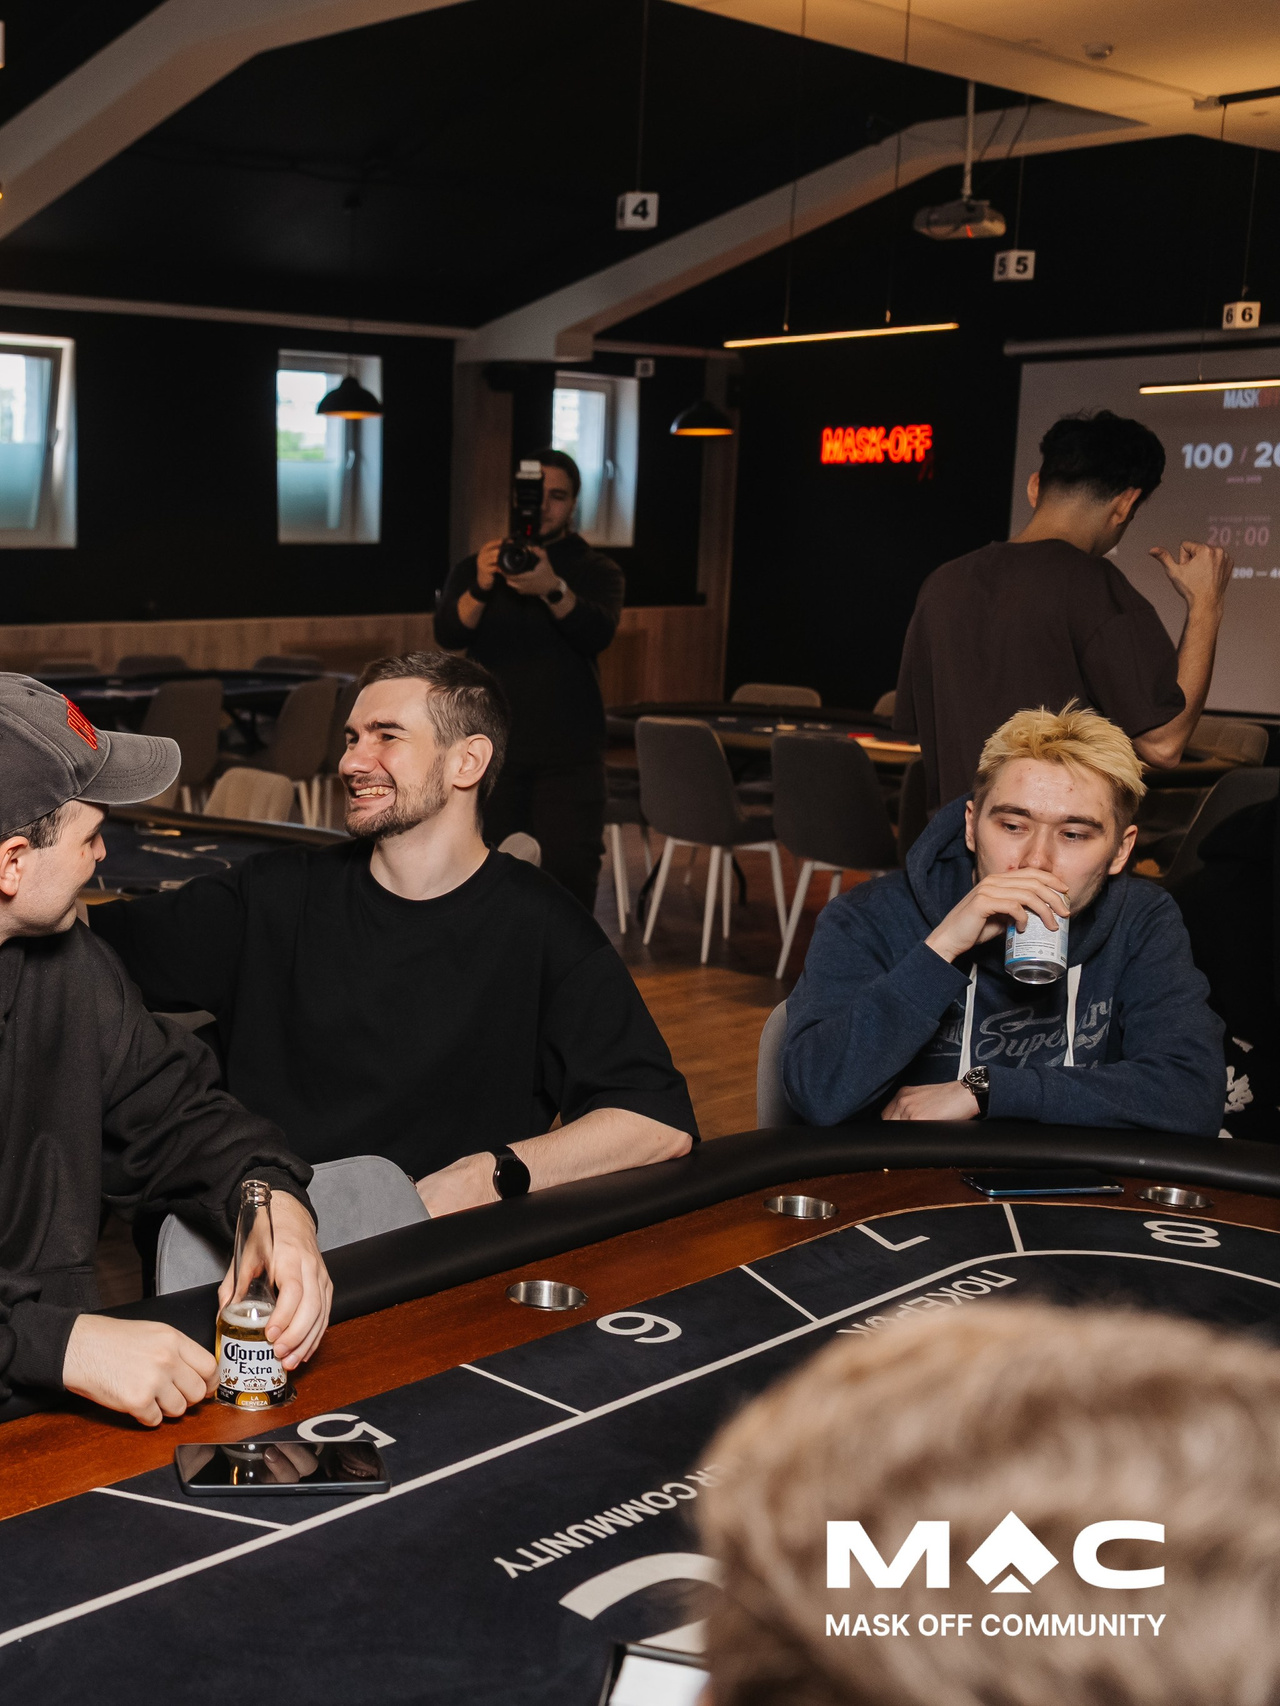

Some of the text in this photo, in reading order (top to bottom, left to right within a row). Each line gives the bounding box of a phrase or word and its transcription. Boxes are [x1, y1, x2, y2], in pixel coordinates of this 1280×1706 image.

[632, 198, 649, 220] 4
[1015, 256, 1028, 274] 5
[1241, 307, 1253, 322] 6
[821, 424, 932, 464] MASK-OFF
[1182, 442, 1233, 469] 100
[854, 1223, 931, 1252] 7
[1143, 1220, 1222, 1248] 8
[223, 1341, 275, 1365] Coron
[238, 1361, 273, 1375] Extra
[296, 1412, 397, 1449] 5
[493, 1482, 698, 1579] COMMUNITY
